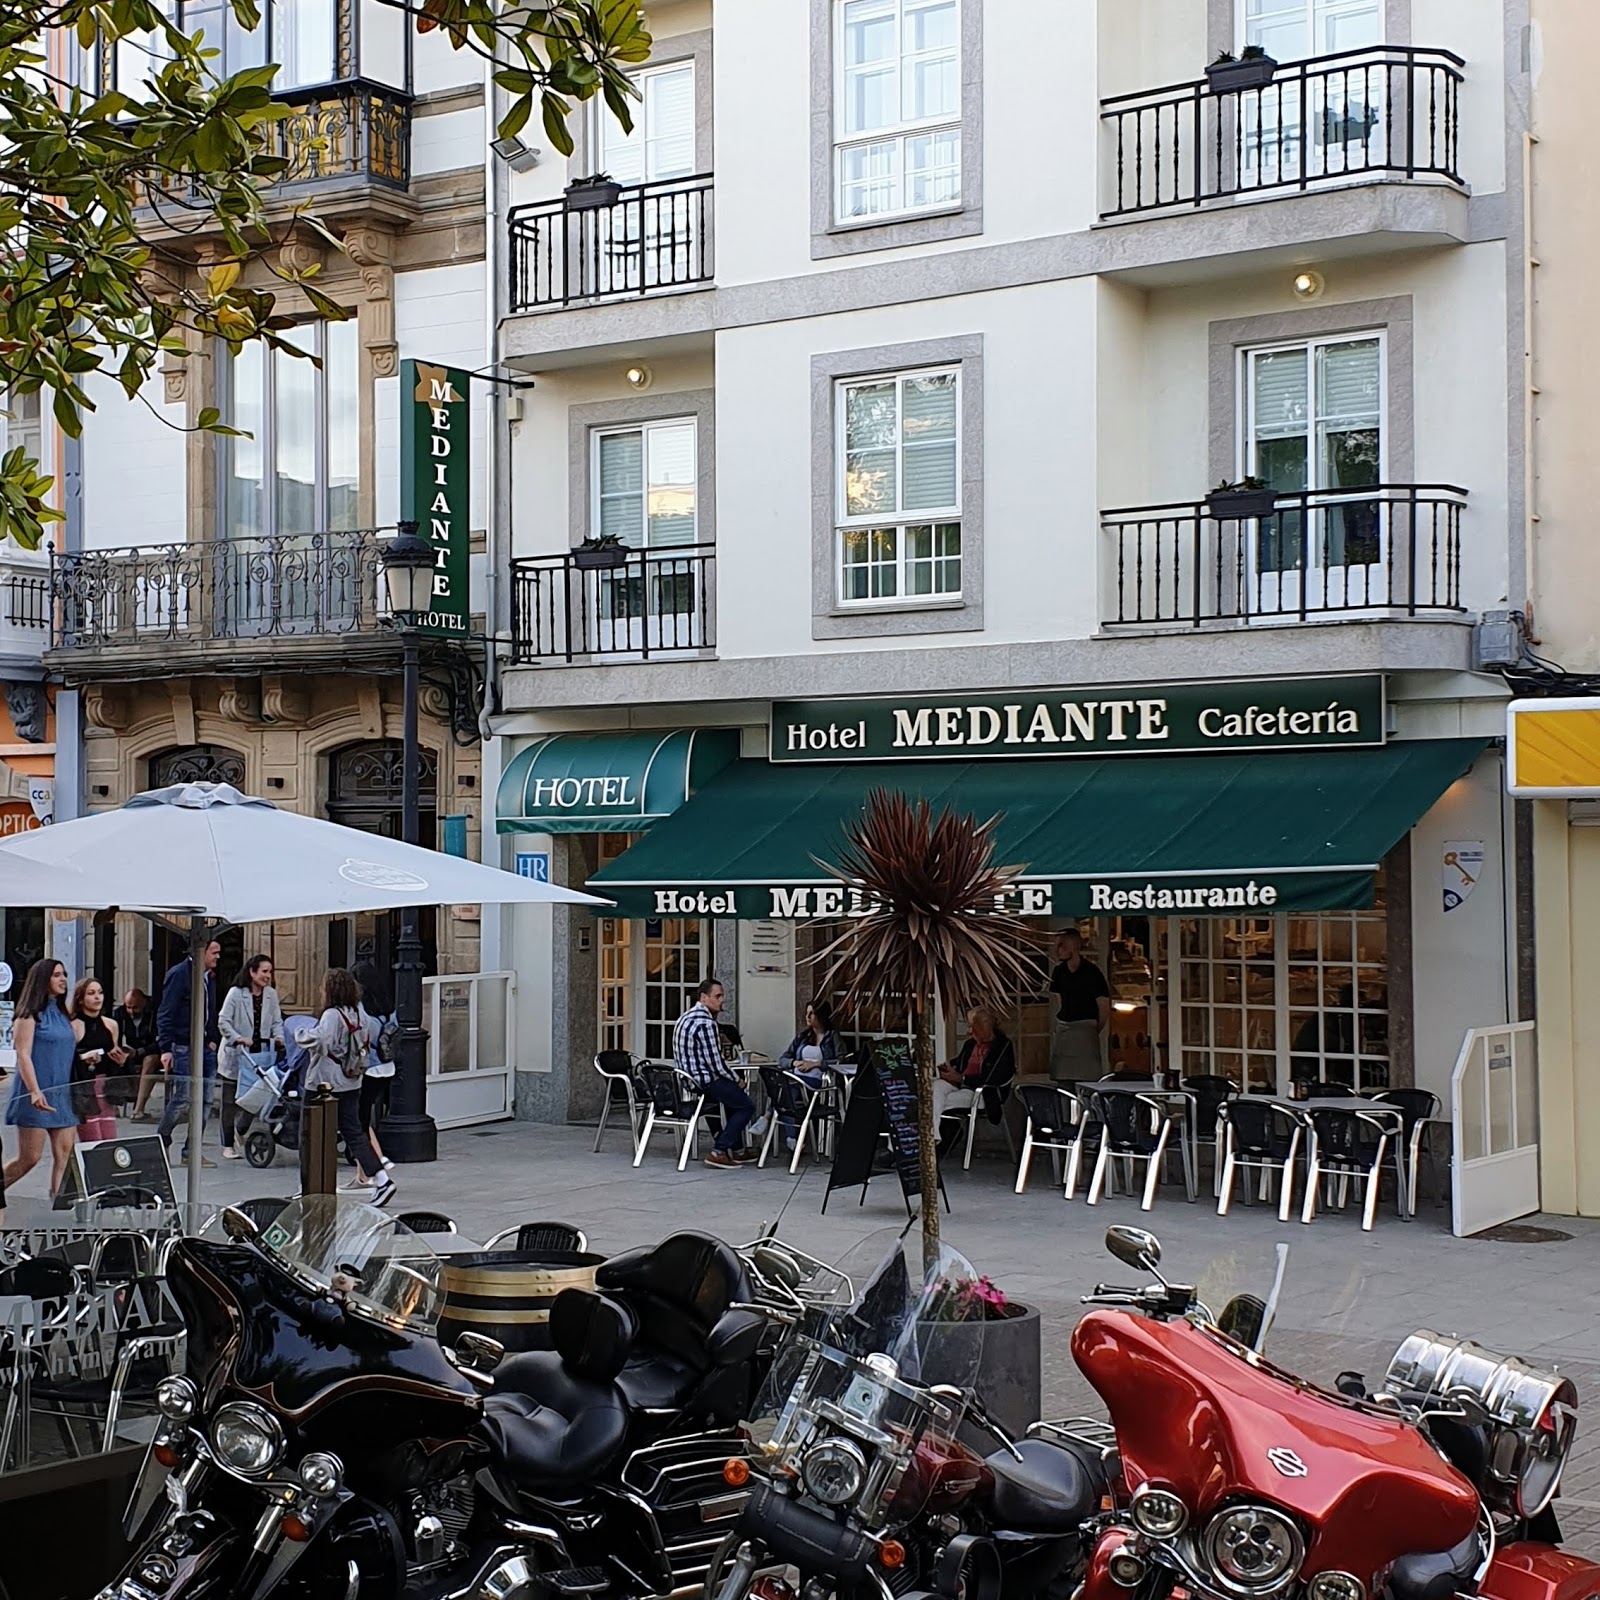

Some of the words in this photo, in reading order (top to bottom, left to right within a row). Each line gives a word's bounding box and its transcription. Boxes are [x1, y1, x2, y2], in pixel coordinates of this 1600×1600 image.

[431, 378, 451, 597] MEDIANTE
[787, 720, 867, 750] Hotel
[892, 699, 1169, 747] MEDIANTE
[1198, 701, 1360, 738] Cafetería
[532, 776, 636, 807] HOTEL
[518, 857, 547, 880] HR
[654, 890, 738, 914] Hotel
[1089, 880, 1278, 910] Restaurante
